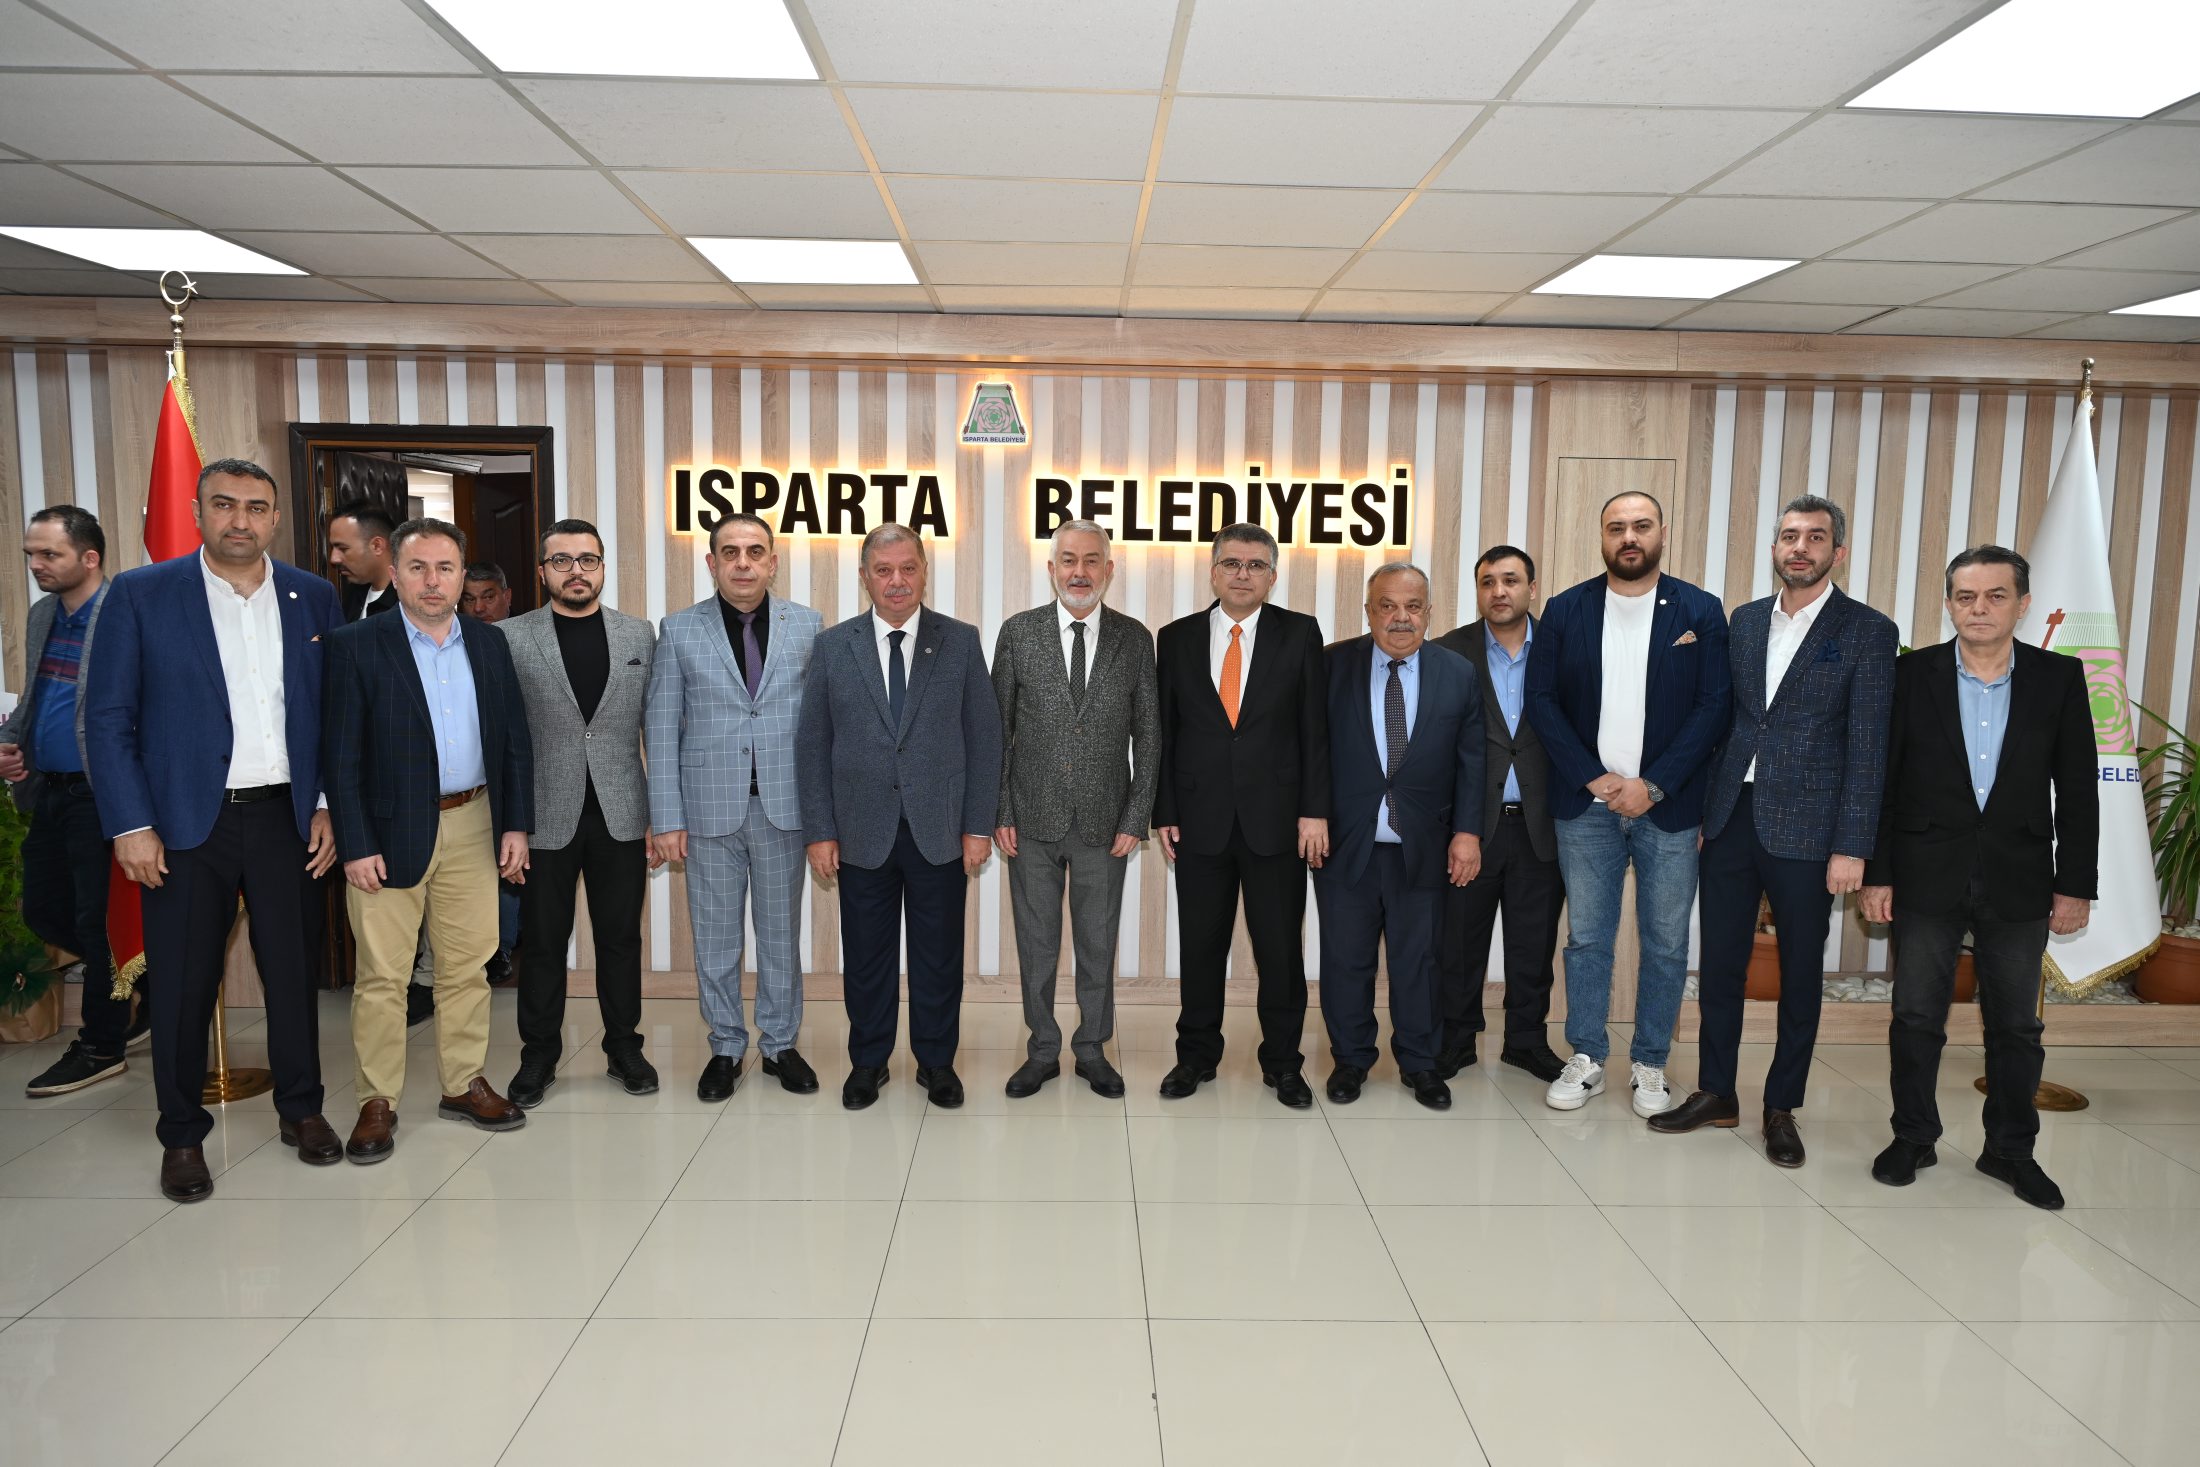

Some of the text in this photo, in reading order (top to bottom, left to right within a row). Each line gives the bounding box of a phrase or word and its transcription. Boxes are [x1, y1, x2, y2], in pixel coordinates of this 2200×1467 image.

[990, 435, 1026, 443] BELEDİYESİ
[676, 466, 1408, 546] ISPARTA BELEDİYESİ
